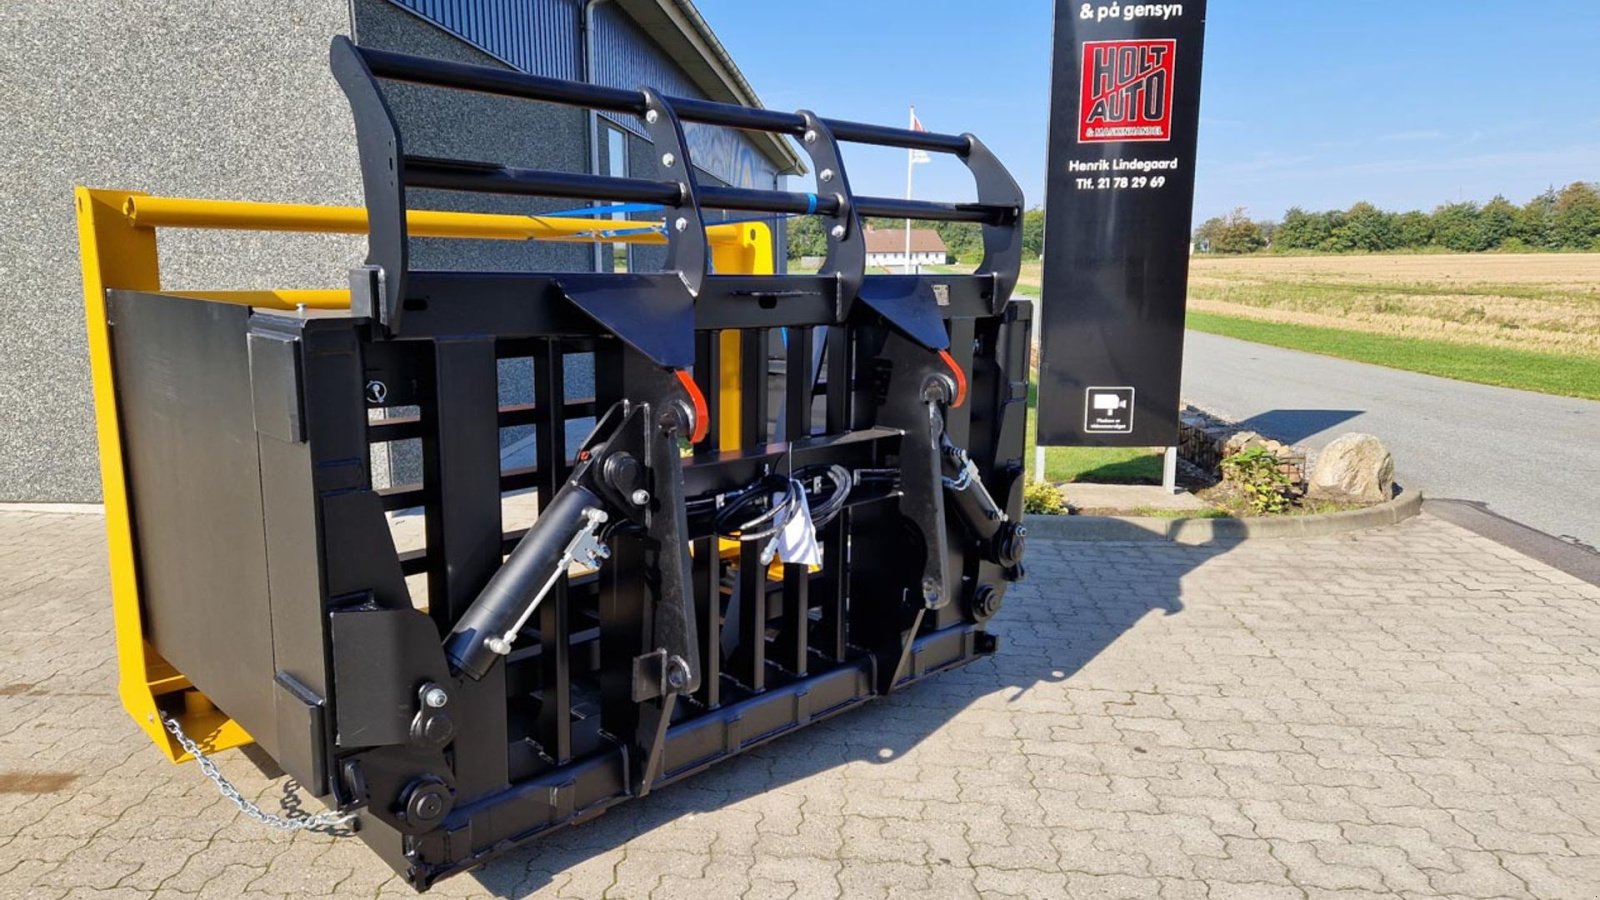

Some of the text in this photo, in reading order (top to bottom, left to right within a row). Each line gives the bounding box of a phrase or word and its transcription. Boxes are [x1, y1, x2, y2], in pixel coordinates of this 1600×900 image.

[1080, 1, 1183, 22] & på gensyn
[1091, 45, 1168, 100] HOLT
[1086, 67, 1167, 123] AUTO
[1069, 157, 1178, 172] Henrik Lindegaard
[1076, 175, 1166, 190] Tlf. 21 78 29 69
